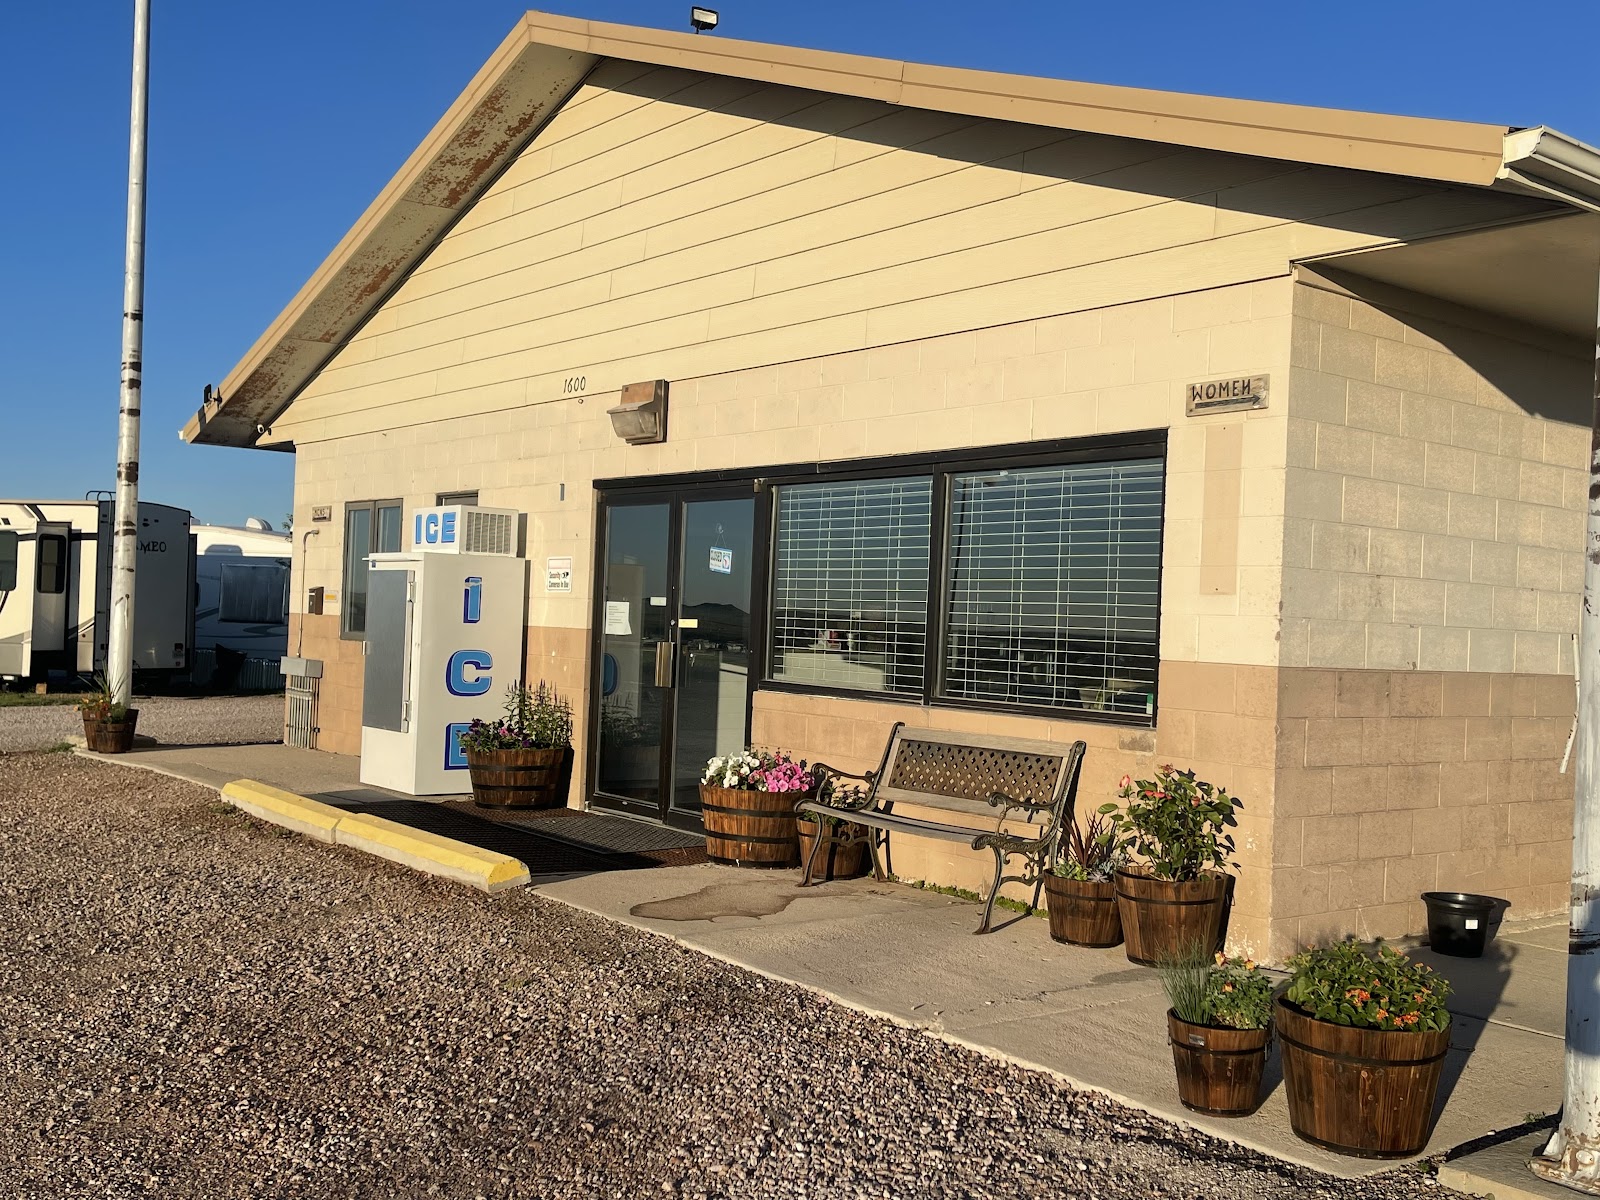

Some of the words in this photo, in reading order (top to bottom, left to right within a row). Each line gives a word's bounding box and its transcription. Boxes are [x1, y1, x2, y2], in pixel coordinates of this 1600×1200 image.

[563, 376, 587, 394] 1600
[1192, 379, 1251, 402] WOMEN
[415, 511, 457, 545] ICE
[136, 540, 167, 554] MEO
